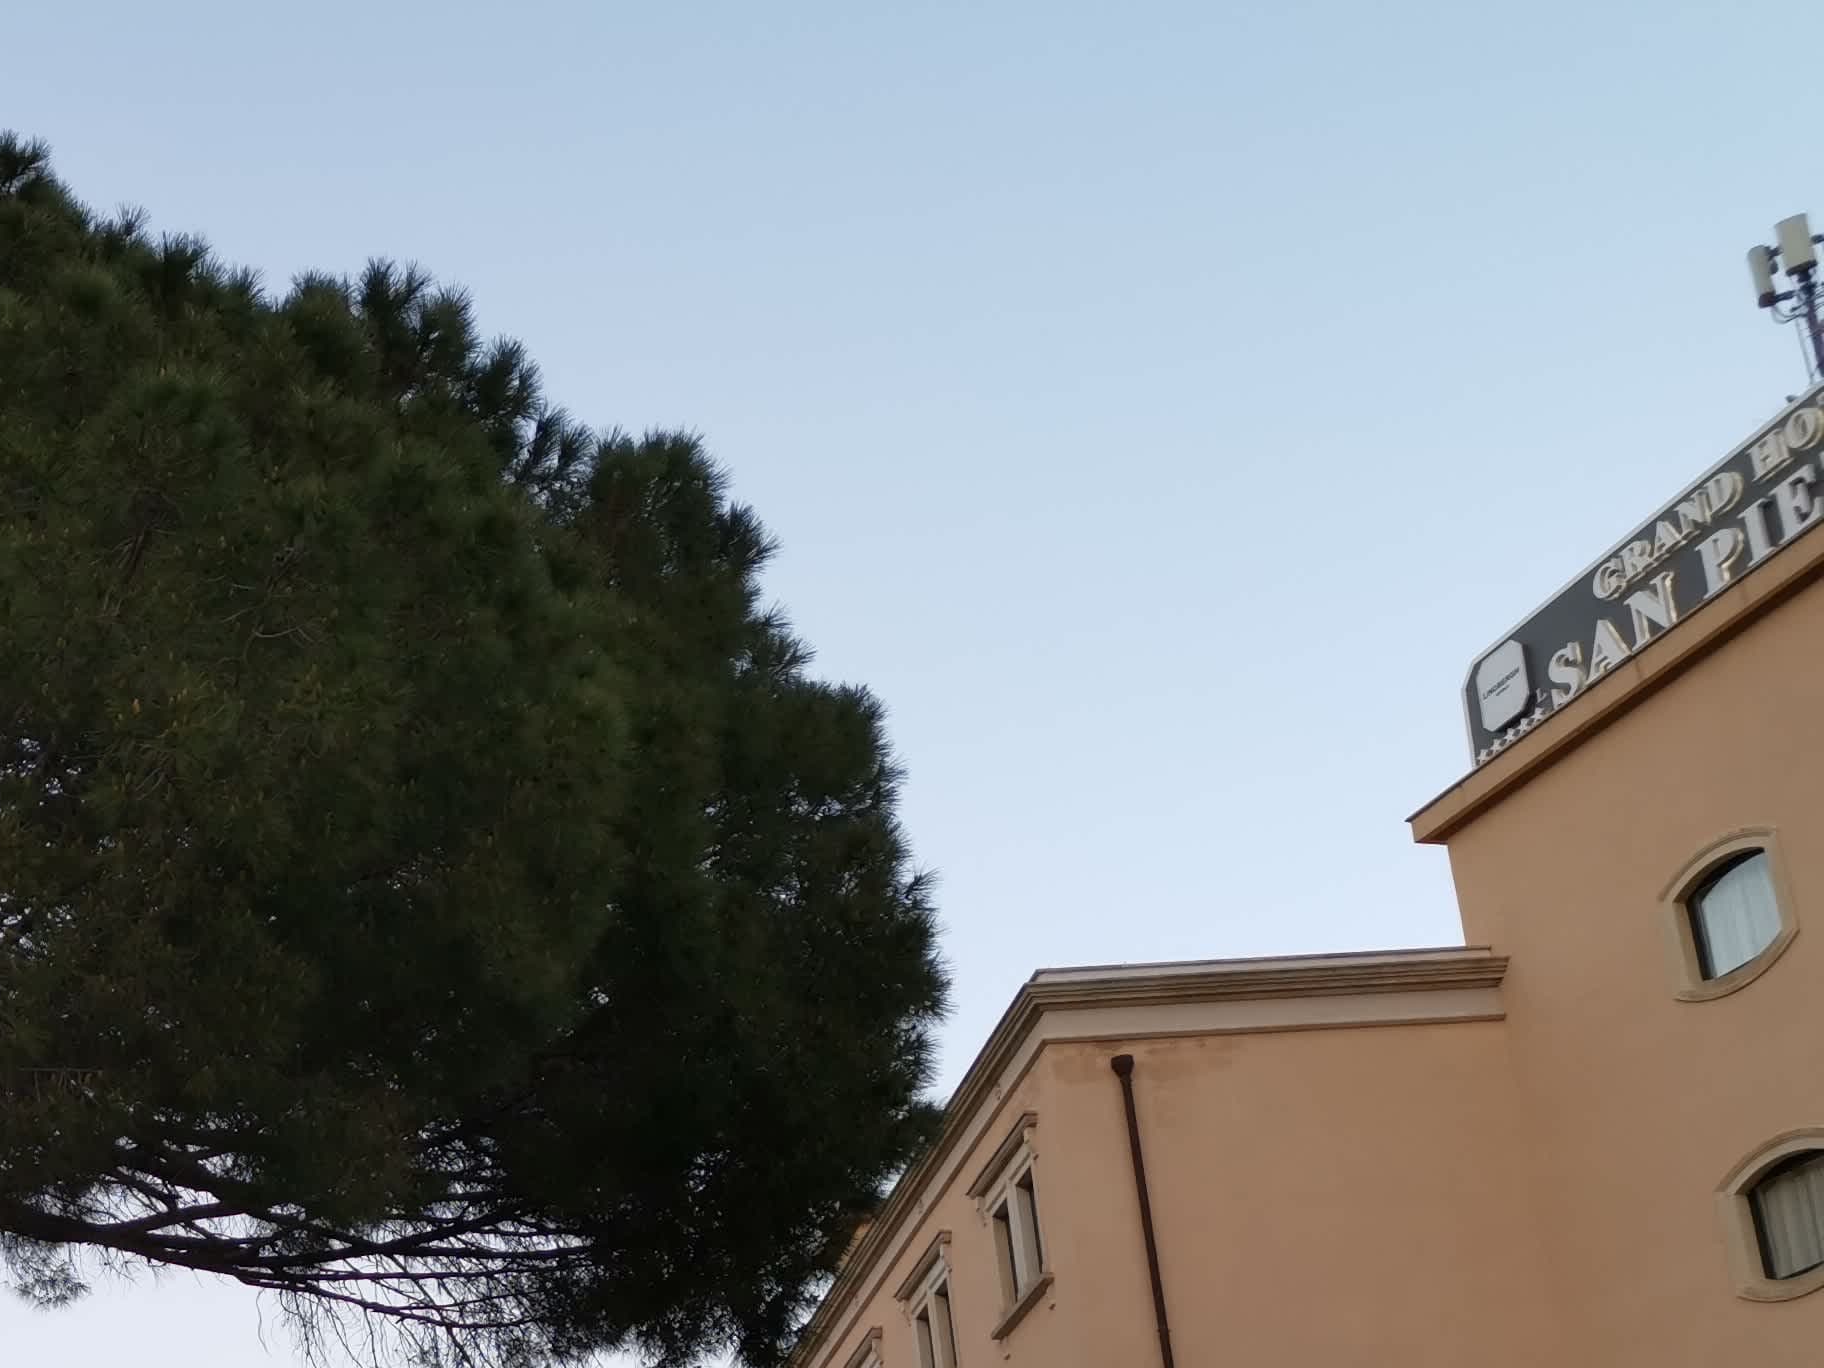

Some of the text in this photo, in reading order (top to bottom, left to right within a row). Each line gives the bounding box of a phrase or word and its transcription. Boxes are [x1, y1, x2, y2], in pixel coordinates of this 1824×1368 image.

[1547, 450, 1824, 712] SAN PIE
[1591, 391, 1824, 602] GRAND HO
